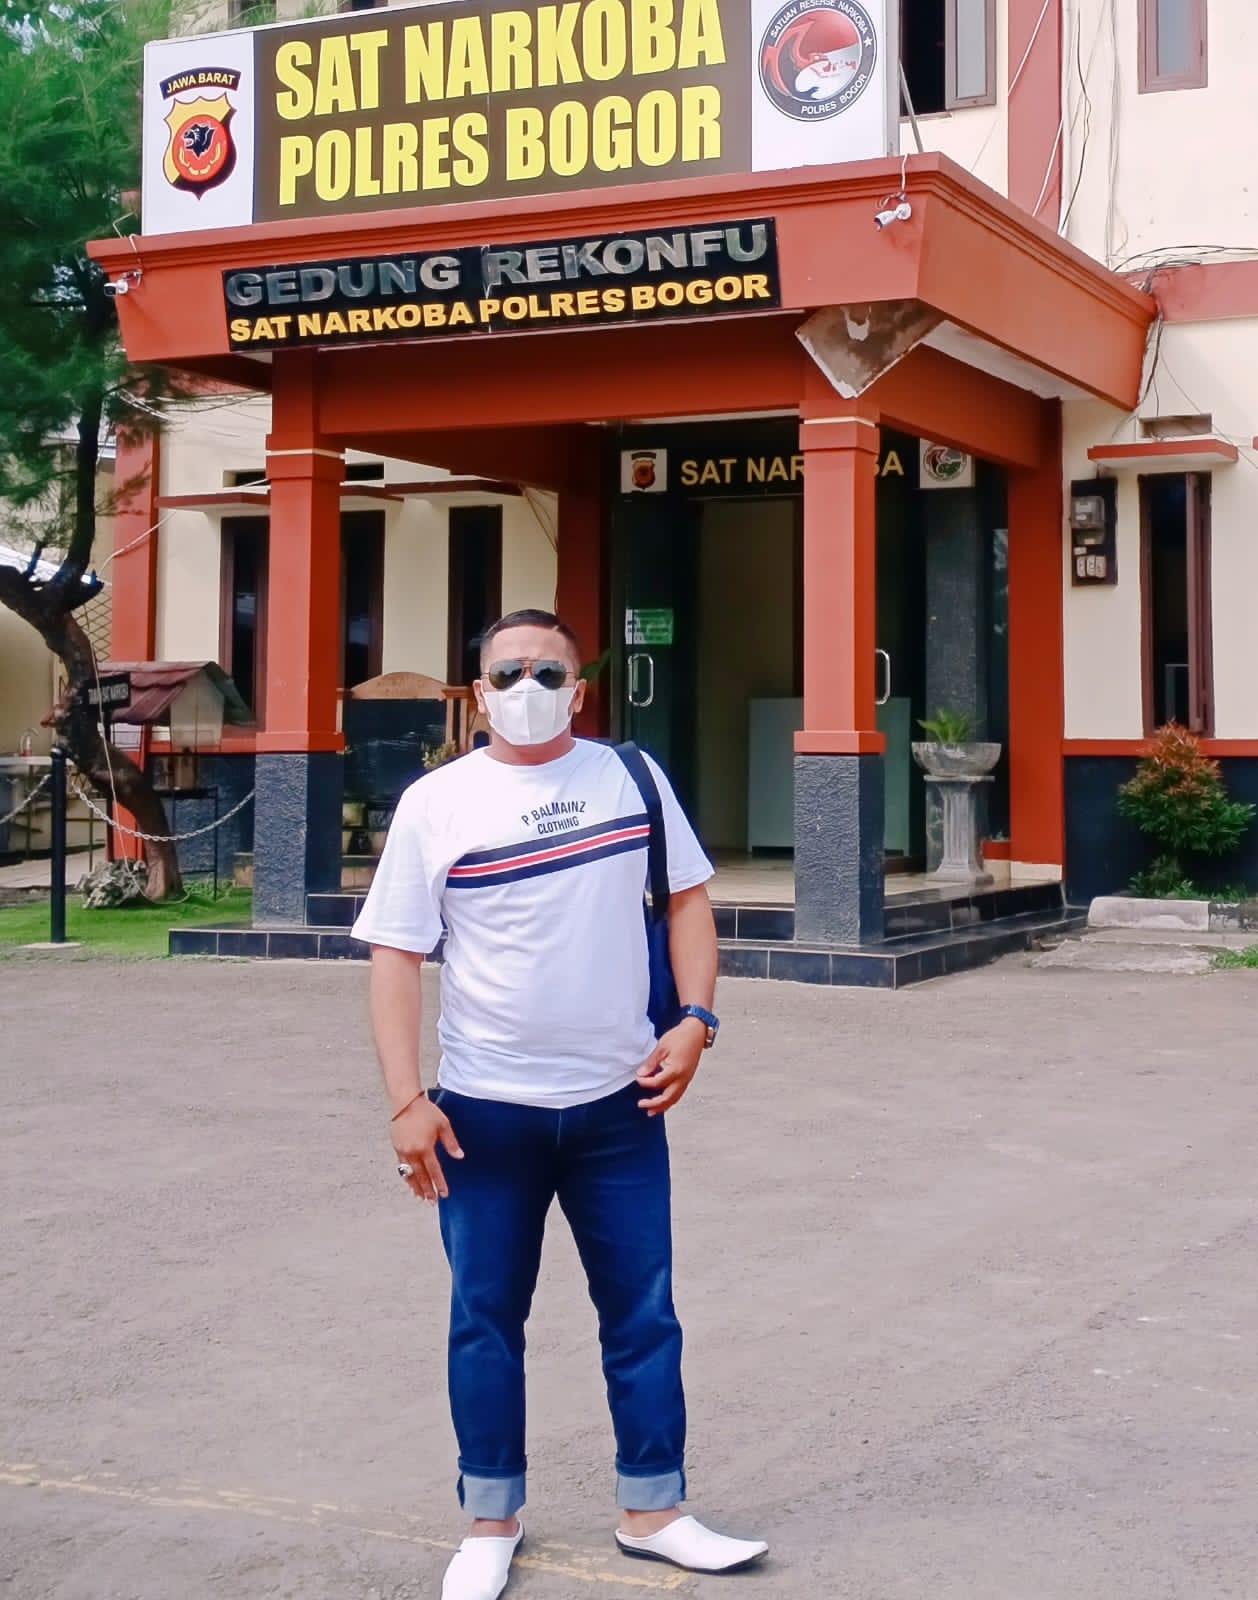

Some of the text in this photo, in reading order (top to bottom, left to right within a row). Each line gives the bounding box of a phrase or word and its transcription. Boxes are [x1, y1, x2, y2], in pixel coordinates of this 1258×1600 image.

[770, 7, 798, 39] SATUAN
[838, 1, 868, 35] NARKOBA
[275, 0, 727, 120] SAT NARKOBA
[167, 73, 235, 93] JAWA BARAT
[801, 73, 867, 115] POLRES BOGOR
[279, 84, 722, 206] POLRES BOGOR
[226, 224, 768, 307] GEDUNG REKONFU
[230, 274, 771, 342] SAT NARKOBA POLRES BOGOR
[680, 450, 905, 486] SAT NARA
[537, 816, 579, 834] CLOTHING
